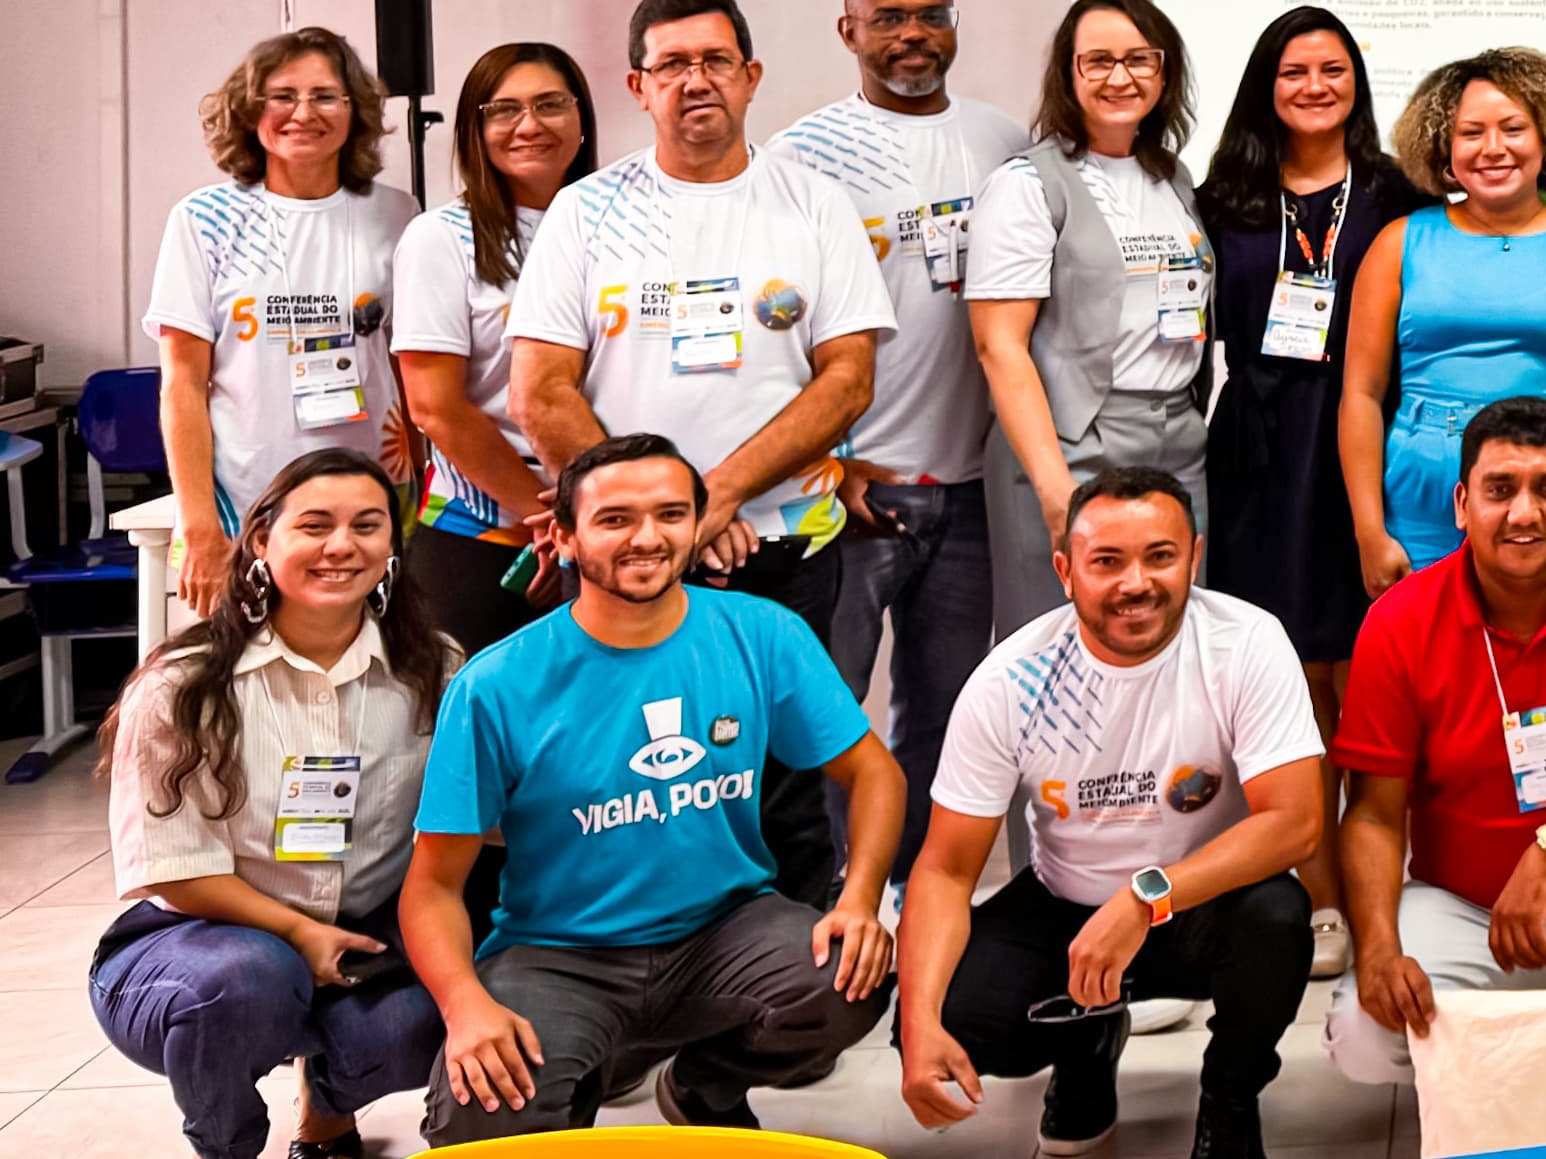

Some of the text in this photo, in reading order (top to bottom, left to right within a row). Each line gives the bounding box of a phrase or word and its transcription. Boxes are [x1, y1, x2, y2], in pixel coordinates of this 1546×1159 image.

[233, 296, 259, 342] 5
[322, 305, 338, 313] DO
[598, 283, 629, 338] 5
[1041, 780, 1070, 820] 5
[1138, 781, 1156, 793] DO
[572, 789, 667, 835] VIGIA,
